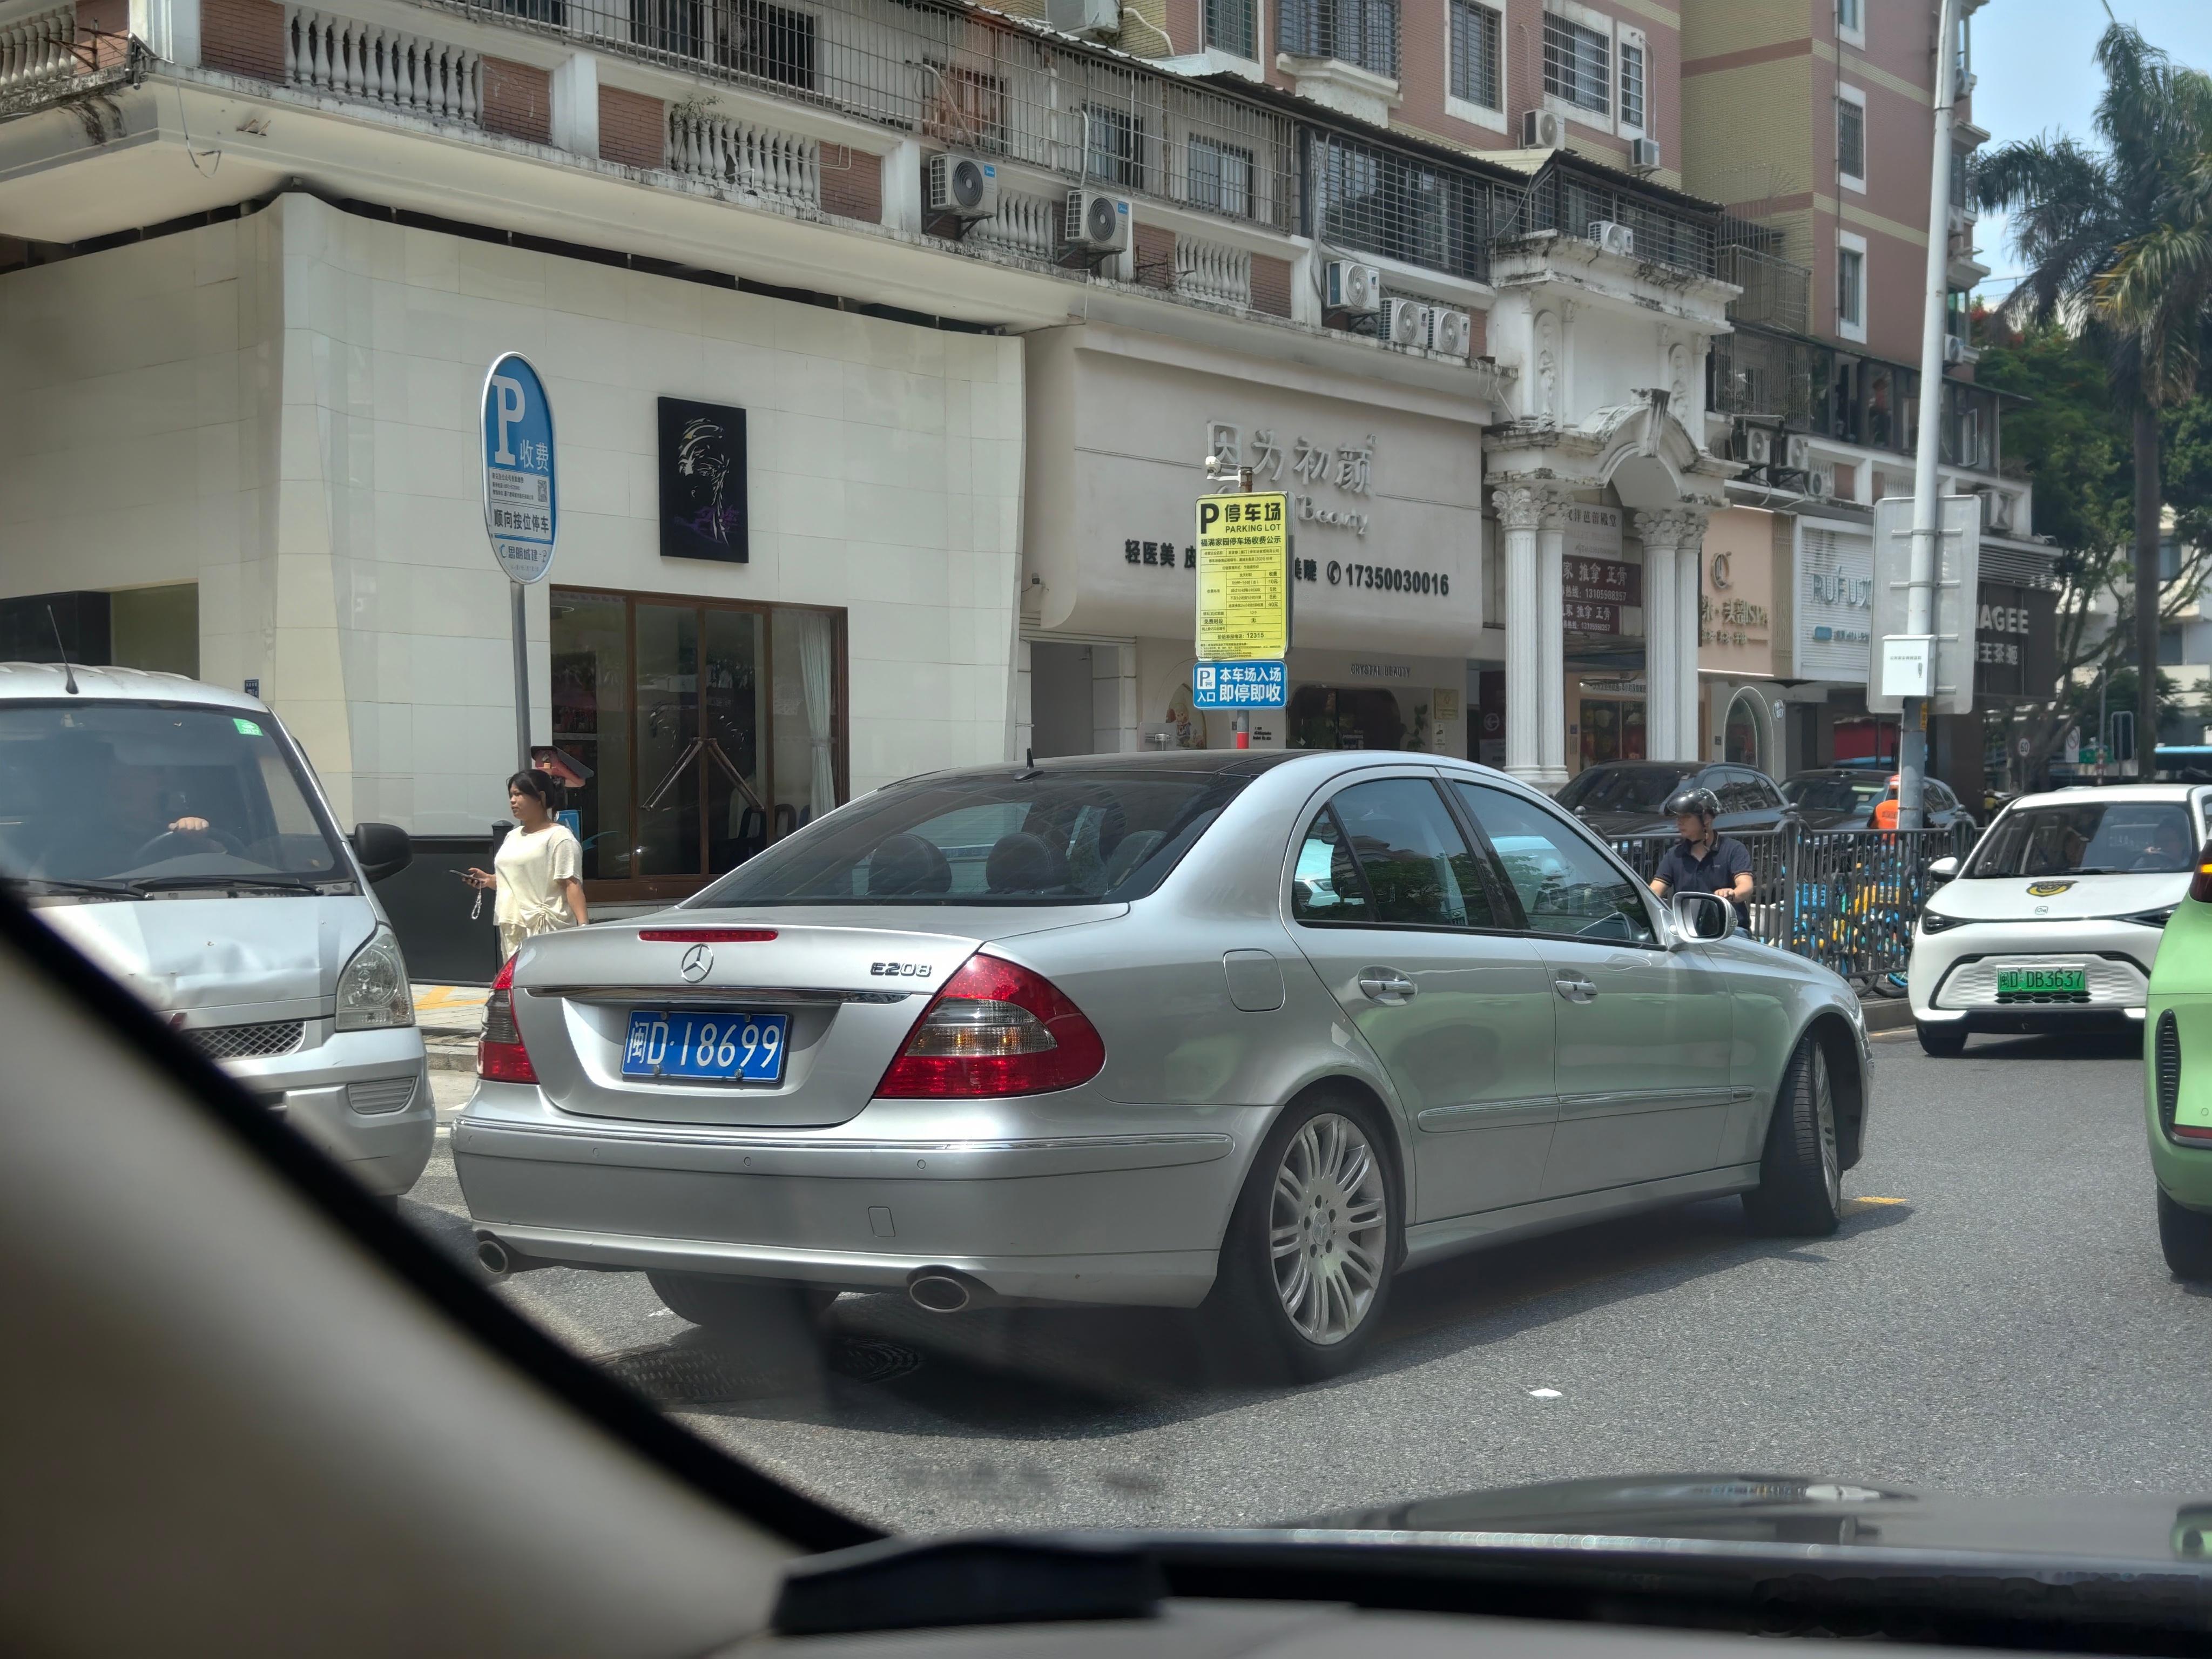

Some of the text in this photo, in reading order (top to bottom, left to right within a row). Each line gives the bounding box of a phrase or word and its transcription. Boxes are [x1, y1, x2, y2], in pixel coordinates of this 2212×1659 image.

[492, 375, 525, 466] P
[520, 439, 549, 471] 收费
[1206, 420, 1373, 495] 因为初颜
[494, 509, 549, 534] 顺向按位停车
[1201, 503, 1219, 534] P
[1224, 502, 1281, 523] 停车场
[1297, 495, 1367, 535] Beauty
[1225, 524, 1263, 533] PARKING
[1201, 536, 1282, 547] 福满家园停车场收费公示
[508, 545, 538, 562] 思明城建
[1125, 538, 1175, 567] 轻医美
[1346, 563, 1449, 596] 17350030016
[1579, 562, 1601, 583] 推拿
[1606, 565, 1627, 585] 正骨
[1577, 605, 1592, 619] 推拿
[1596, 606, 1611, 621] 正骨
[1976, 604, 2029, 634] AGEE
[1975, 641, 2018, 665] 王茶姬
[1199, 670, 1211, 687] P
[1219, 667, 1282, 682] 本车场入场
[1351, 664, 1411, 678] CRYSTAL BEAUTY
[1197, 692, 1215, 702] 入口
[1219, 684, 1282, 702] 即停即收
